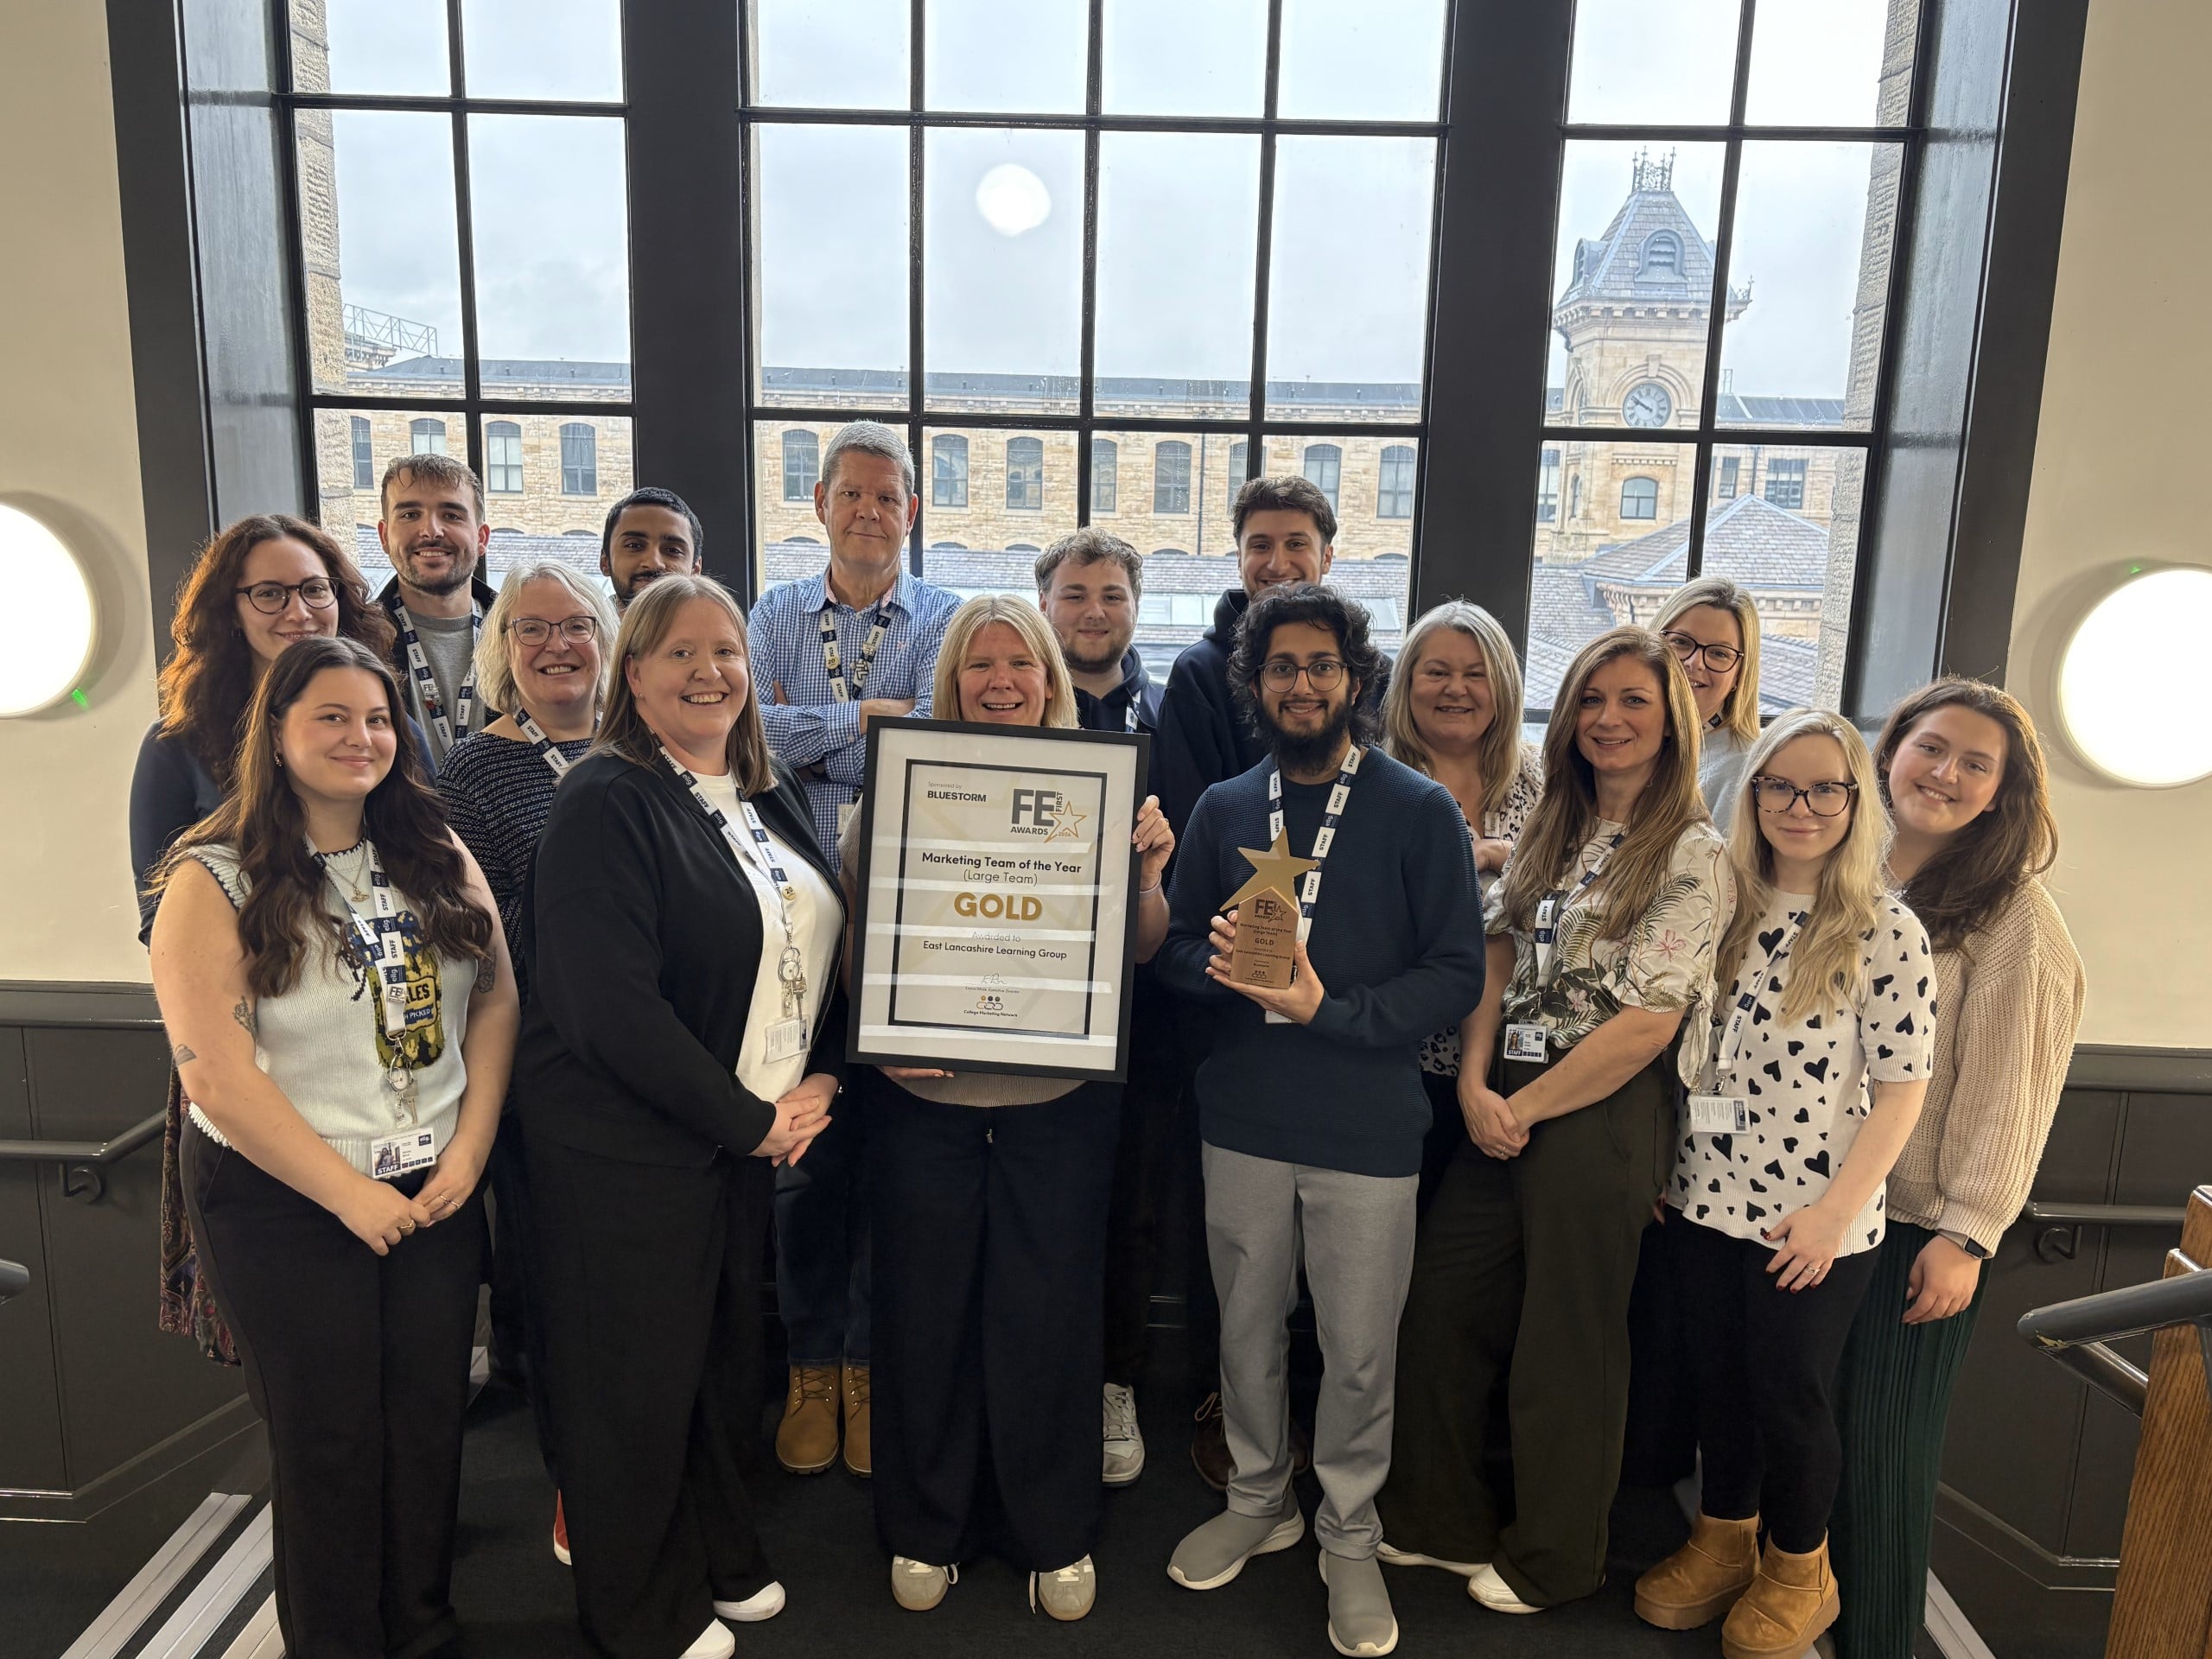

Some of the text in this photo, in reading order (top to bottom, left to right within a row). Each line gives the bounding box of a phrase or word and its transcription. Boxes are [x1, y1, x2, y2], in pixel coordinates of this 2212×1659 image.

[397, 613, 407, 627] STAFF
[871, 631, 880, 645] STAFF
[411, 648, 422, 663] STAFF
[836, 683, 844, 698] STAFF
[438, 722, 448, 739] STAFF
[527, 725, 539, 737] STAFF
[550, 753, 563, 767] STAFF
[663, 753, 678, 770] STAFF
[1348, 752, 1357, 768] STAFF
[694, 791, 710, 809] STAFF
[927, 790, 987, 803] BLUESTORM
[1055, 791, 1064, 813] FIRST
[1333, 791, 1344, 809] STAFF
[746, 807, 757, 824] STAFF
[1011, 788, 1057, 827] FE
[1010, 826, 1049, 836] AWARDS
[1319, 834, 1328, 851] STAFF
[765, 848, 776, 863] STAFF
[922, 852, 1082, 874] Marketing Team of the Year
[963, 868, 1038, 887] (Large Team)
[785, 887, 794, 895] 20
[1307, 878, 1316, 896] STAFF
[380, 893, 389, 912] STAFF
[954, 892, 1043, 921] GOLD
[1255, 899, 1274, 916] FE
[357, 919, 371, 937] STAFF
[971, 931, 1021, 943] Awarded to
[1255, 938, 1274, 946] GOLD
[1785, 931, 1798, 948] STAFF
[389, 939, 397, 959] STAFF
[923, 940, 1067, 961] East Lancashire Learning Group
[405, 983, 430, 1004] LES
[409, 1008, 430, 1019] PICKED
[1732, 1015, 1742, 1033] STAFF
[377, 1164, 399, 1174] STAFF
